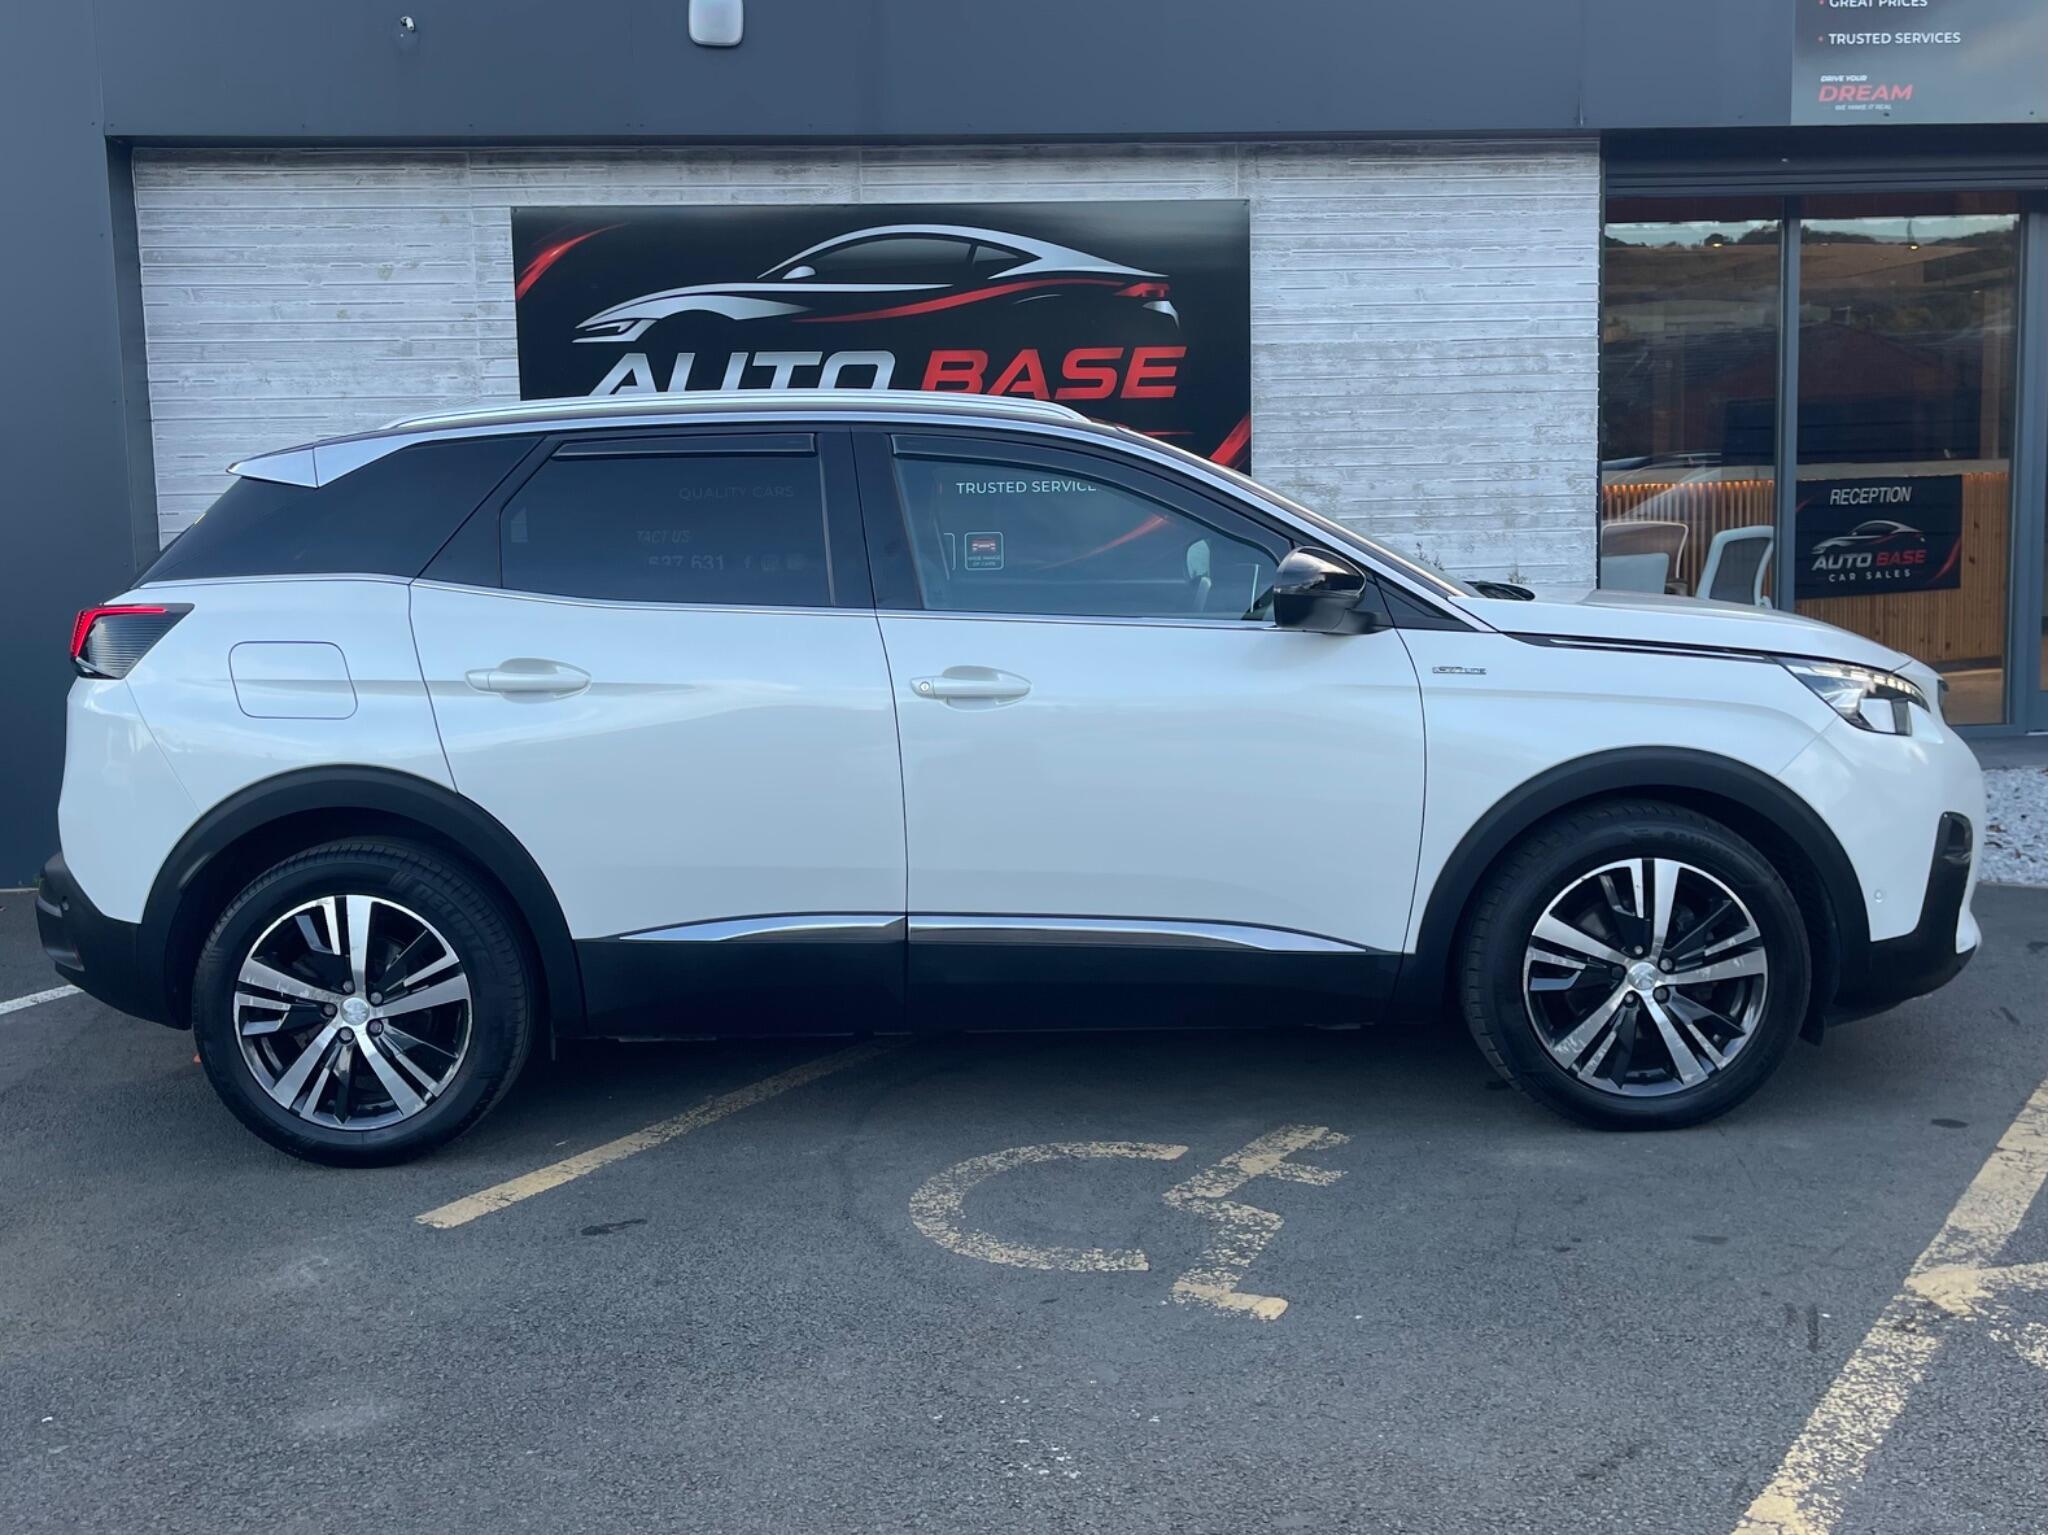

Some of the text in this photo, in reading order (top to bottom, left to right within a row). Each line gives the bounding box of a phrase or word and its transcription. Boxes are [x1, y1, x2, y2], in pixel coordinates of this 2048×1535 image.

[1829, 0, 1873, 8] GREAT
[1828, 32, 1961, 45] TRUSTED SERVICES
[1818, 84, 1913, 102] DREAM
[588, 346, 1187, 400] AUTO BASE
[679, 485, 795, 501] QUALITY CARS
[956, 481, 1027, 494] TRUSTED
[1830, 487, 1912, 505] RECEPTION
[671, 529, 692, 544] US
[1812, 551, 1926, 571] AUTO BASE
[1829, 568, 1911, 582] CAR SALES
